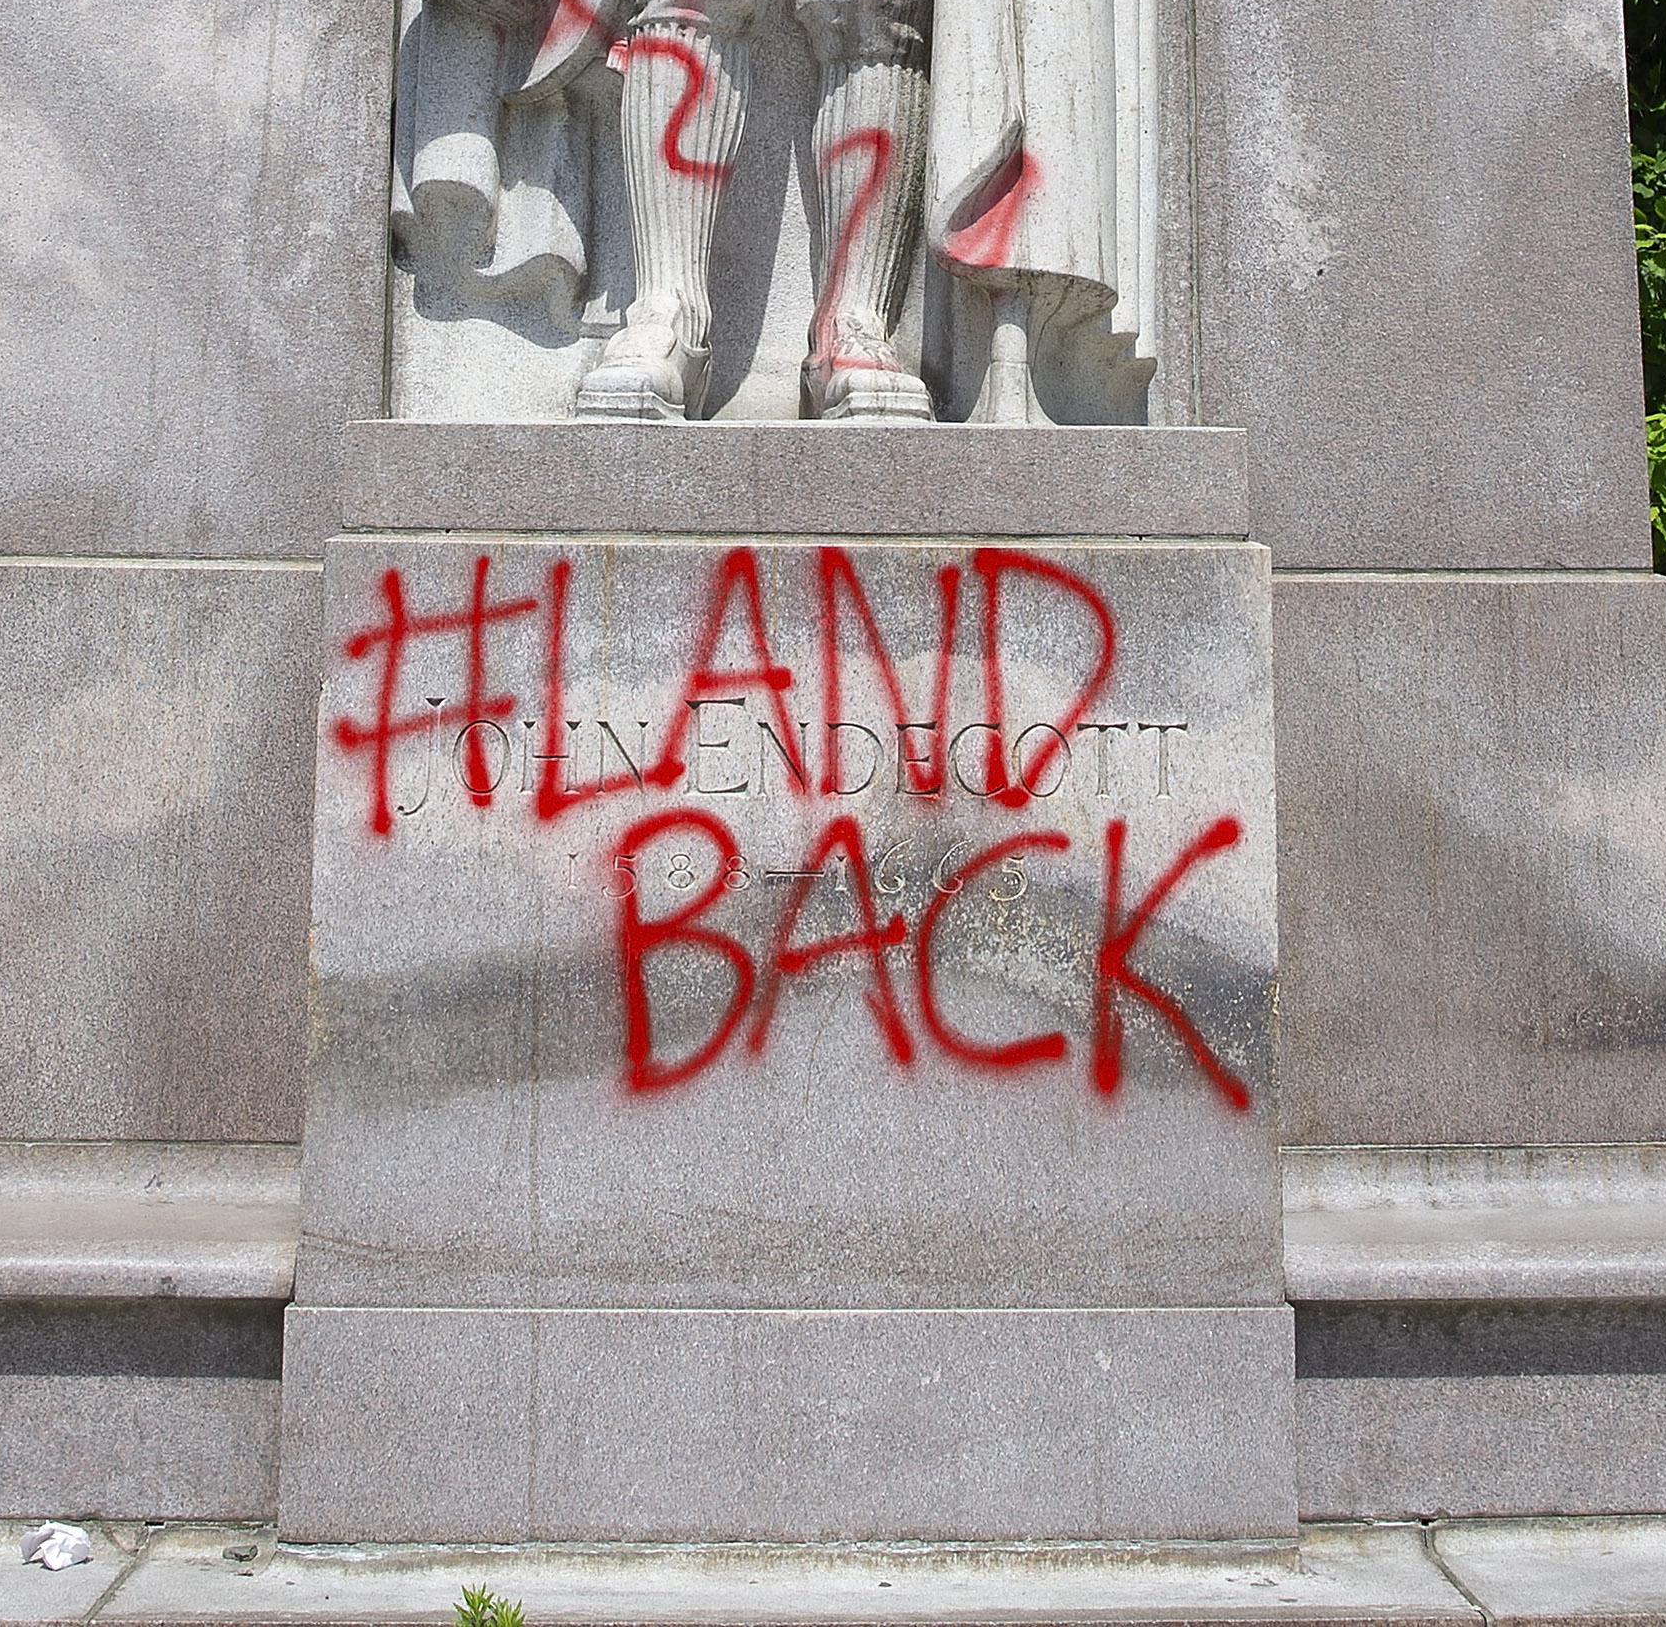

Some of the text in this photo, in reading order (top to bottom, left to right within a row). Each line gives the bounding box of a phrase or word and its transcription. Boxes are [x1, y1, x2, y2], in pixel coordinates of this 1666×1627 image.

[333, 547, 1117, 834] #LAND
[397, 697, 1189, 815] JOHN ENDECOTT
[615, 807, 1251, 1110] BACK
